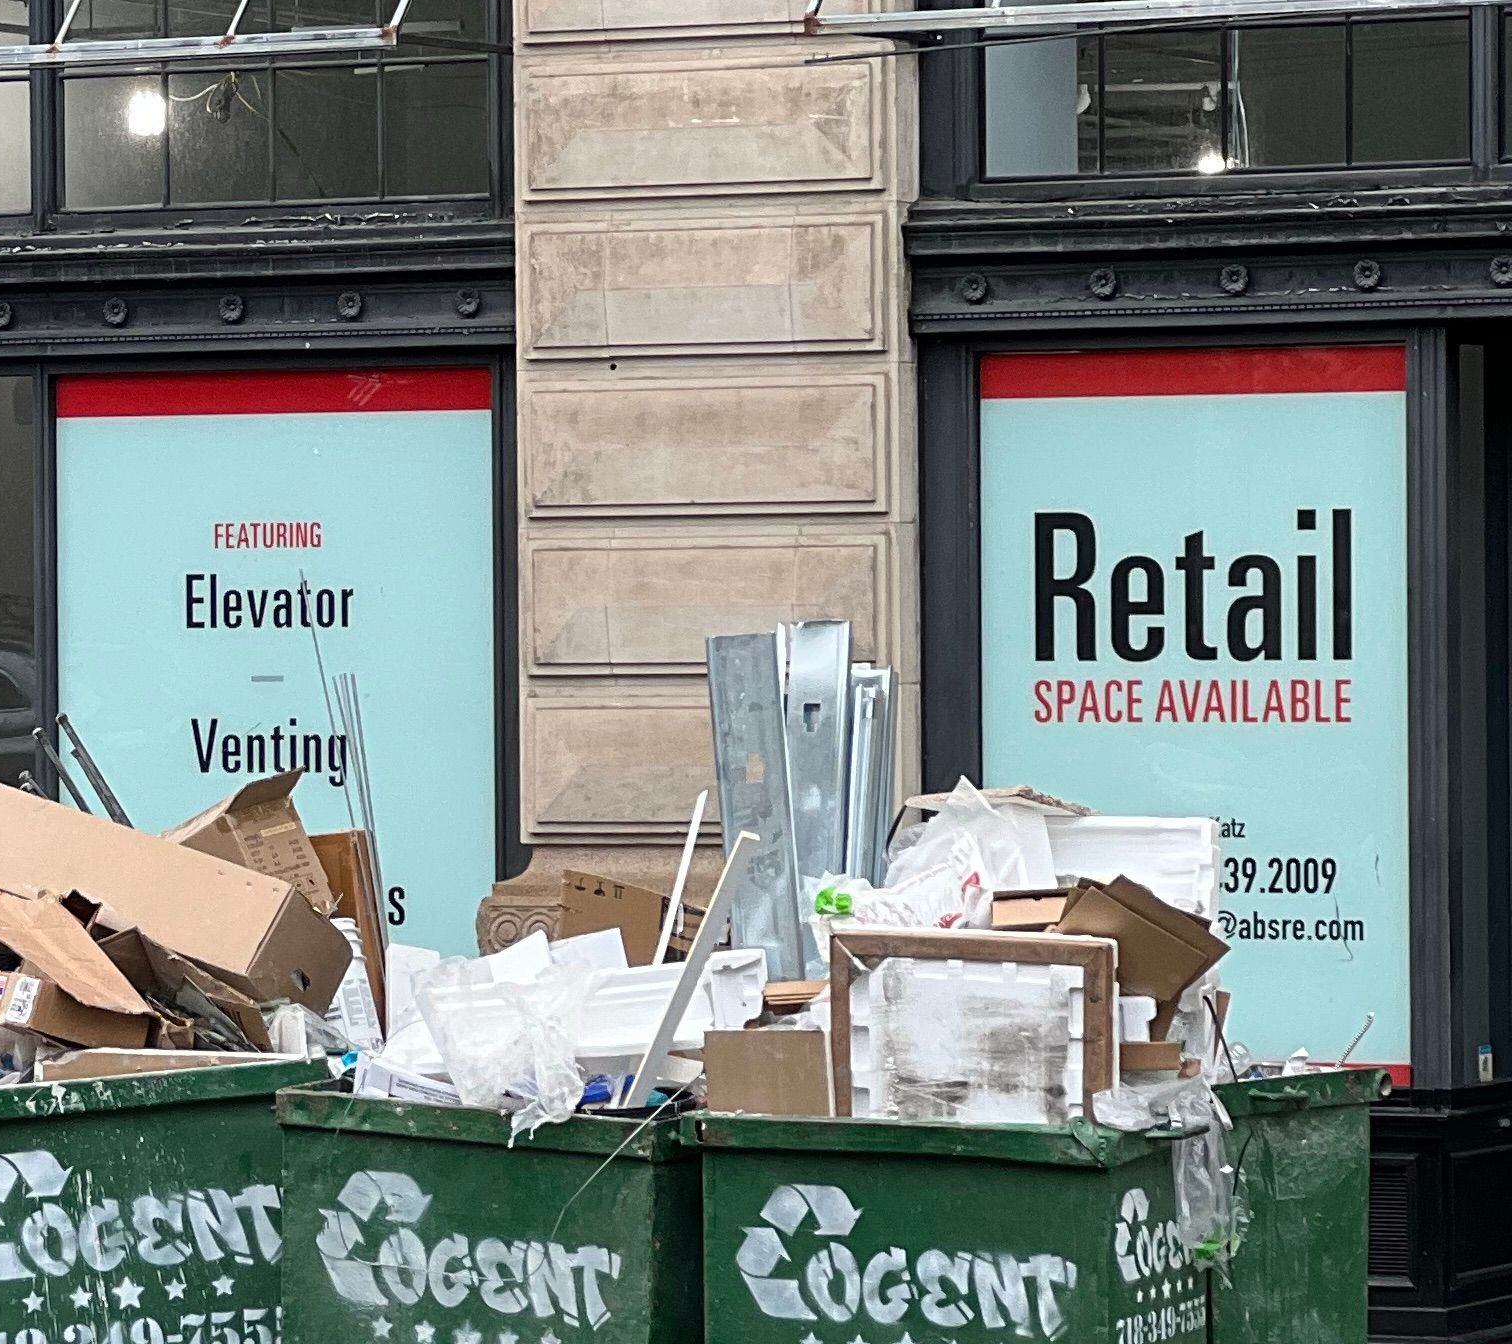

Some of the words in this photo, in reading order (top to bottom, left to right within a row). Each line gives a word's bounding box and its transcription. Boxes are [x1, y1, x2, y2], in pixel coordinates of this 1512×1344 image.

[213, 522, 323, 549] FEATURING
[185, 572, 355, 629] Elevator
[1034, 508, 1353, 662] Retail
[1033, 679, 1143, 724] SPACE
[1155, 678, 1353, 724] AVAILABLE
[190, 717, 348, 787] Venting
[1210, 815, 1246, 839] atz
[1218, 856, 1338, 894] 39.2009
[1217, 909, 1365, 941] @absre.com
